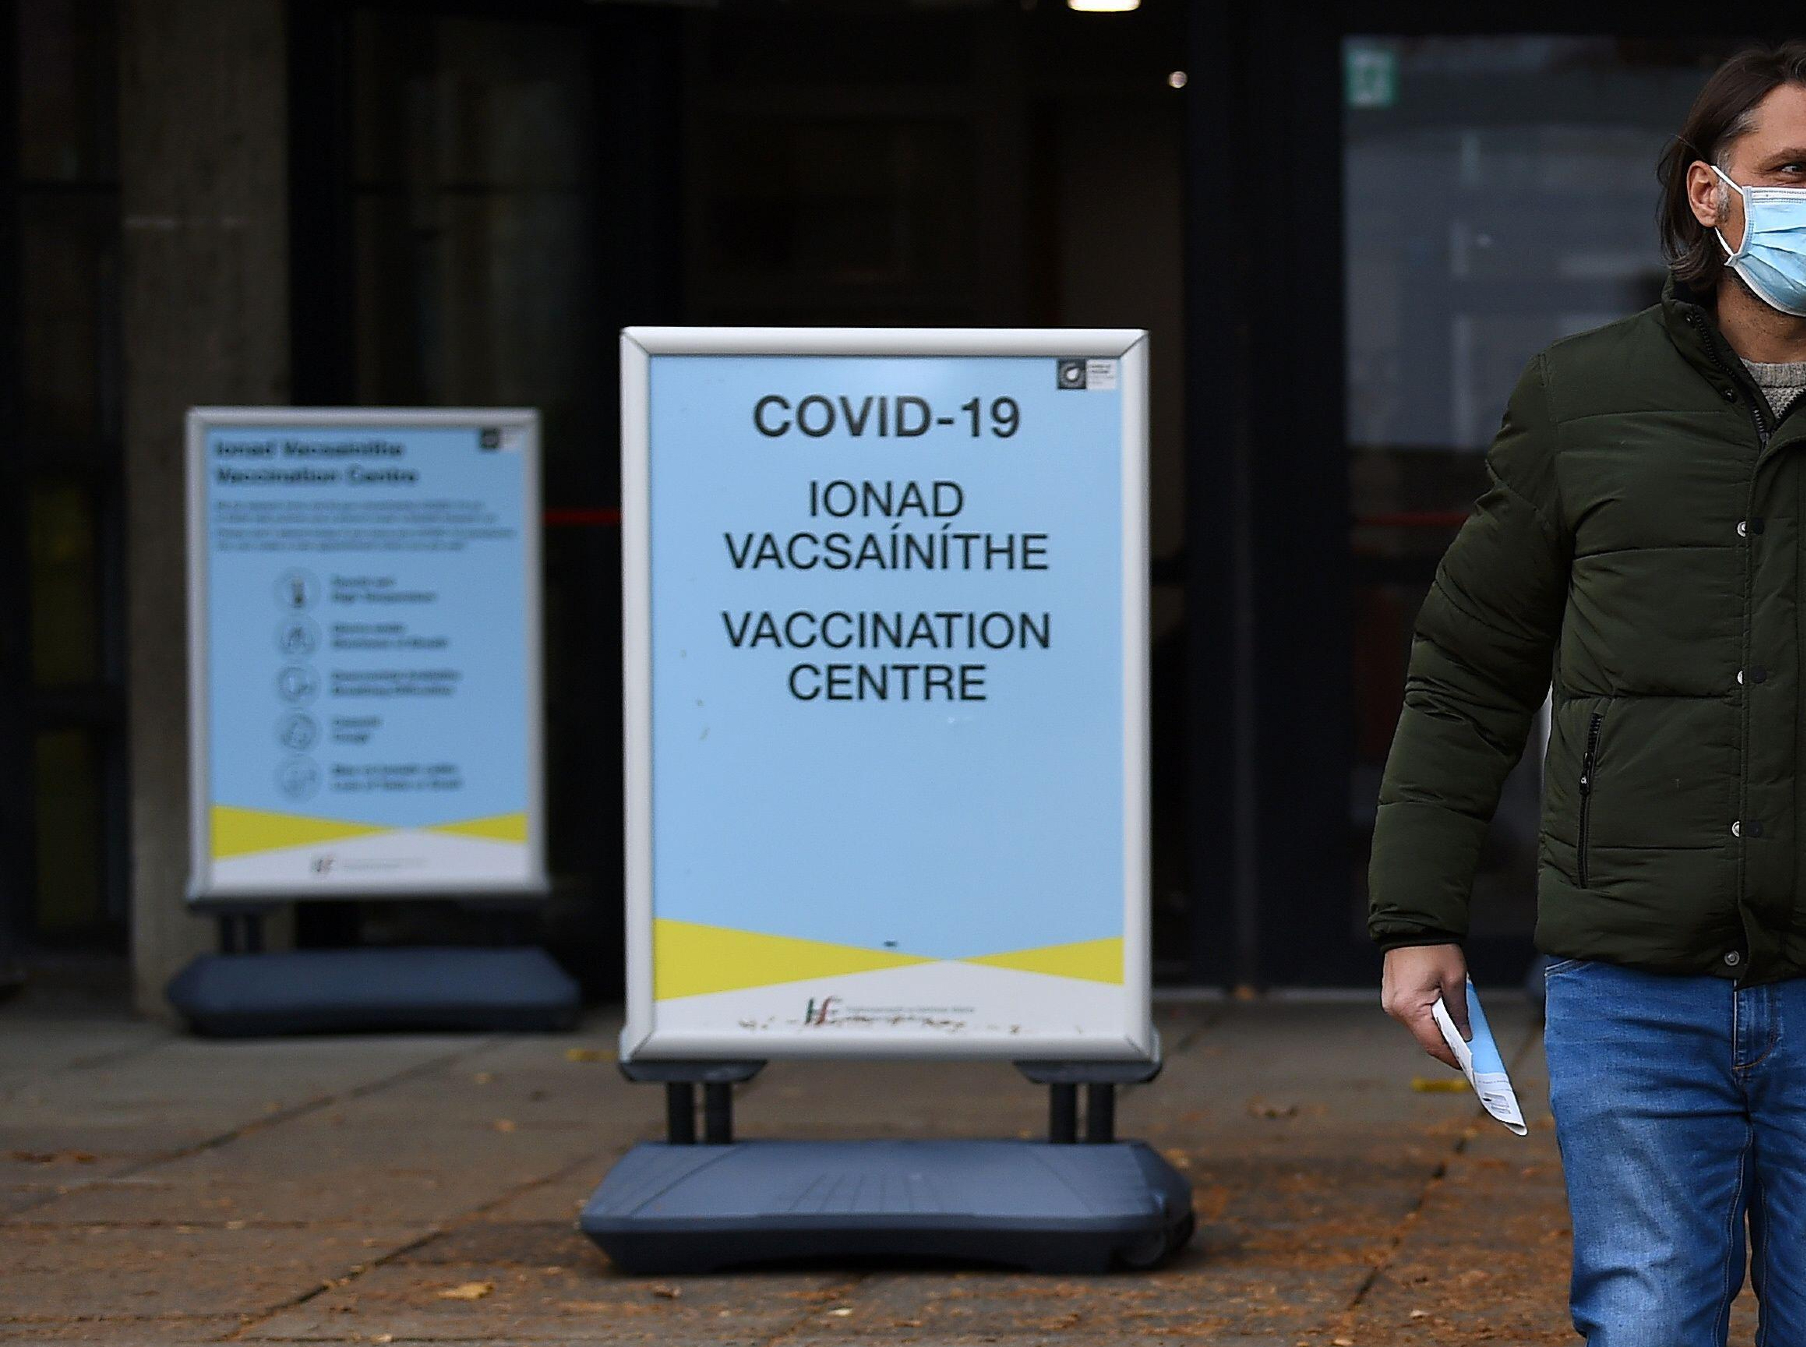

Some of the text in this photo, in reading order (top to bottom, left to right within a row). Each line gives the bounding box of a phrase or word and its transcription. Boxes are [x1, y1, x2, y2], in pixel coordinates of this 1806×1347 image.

[754, 395, 1021, 438] COVID-19
[809, 480, 964, 518] IONAD
[724, 523, 1049, 571] VACSAÍNÍTHE
[722, 611, 1051, 649] VACCINATION
[788, 664, 986, 701] CENTRE
